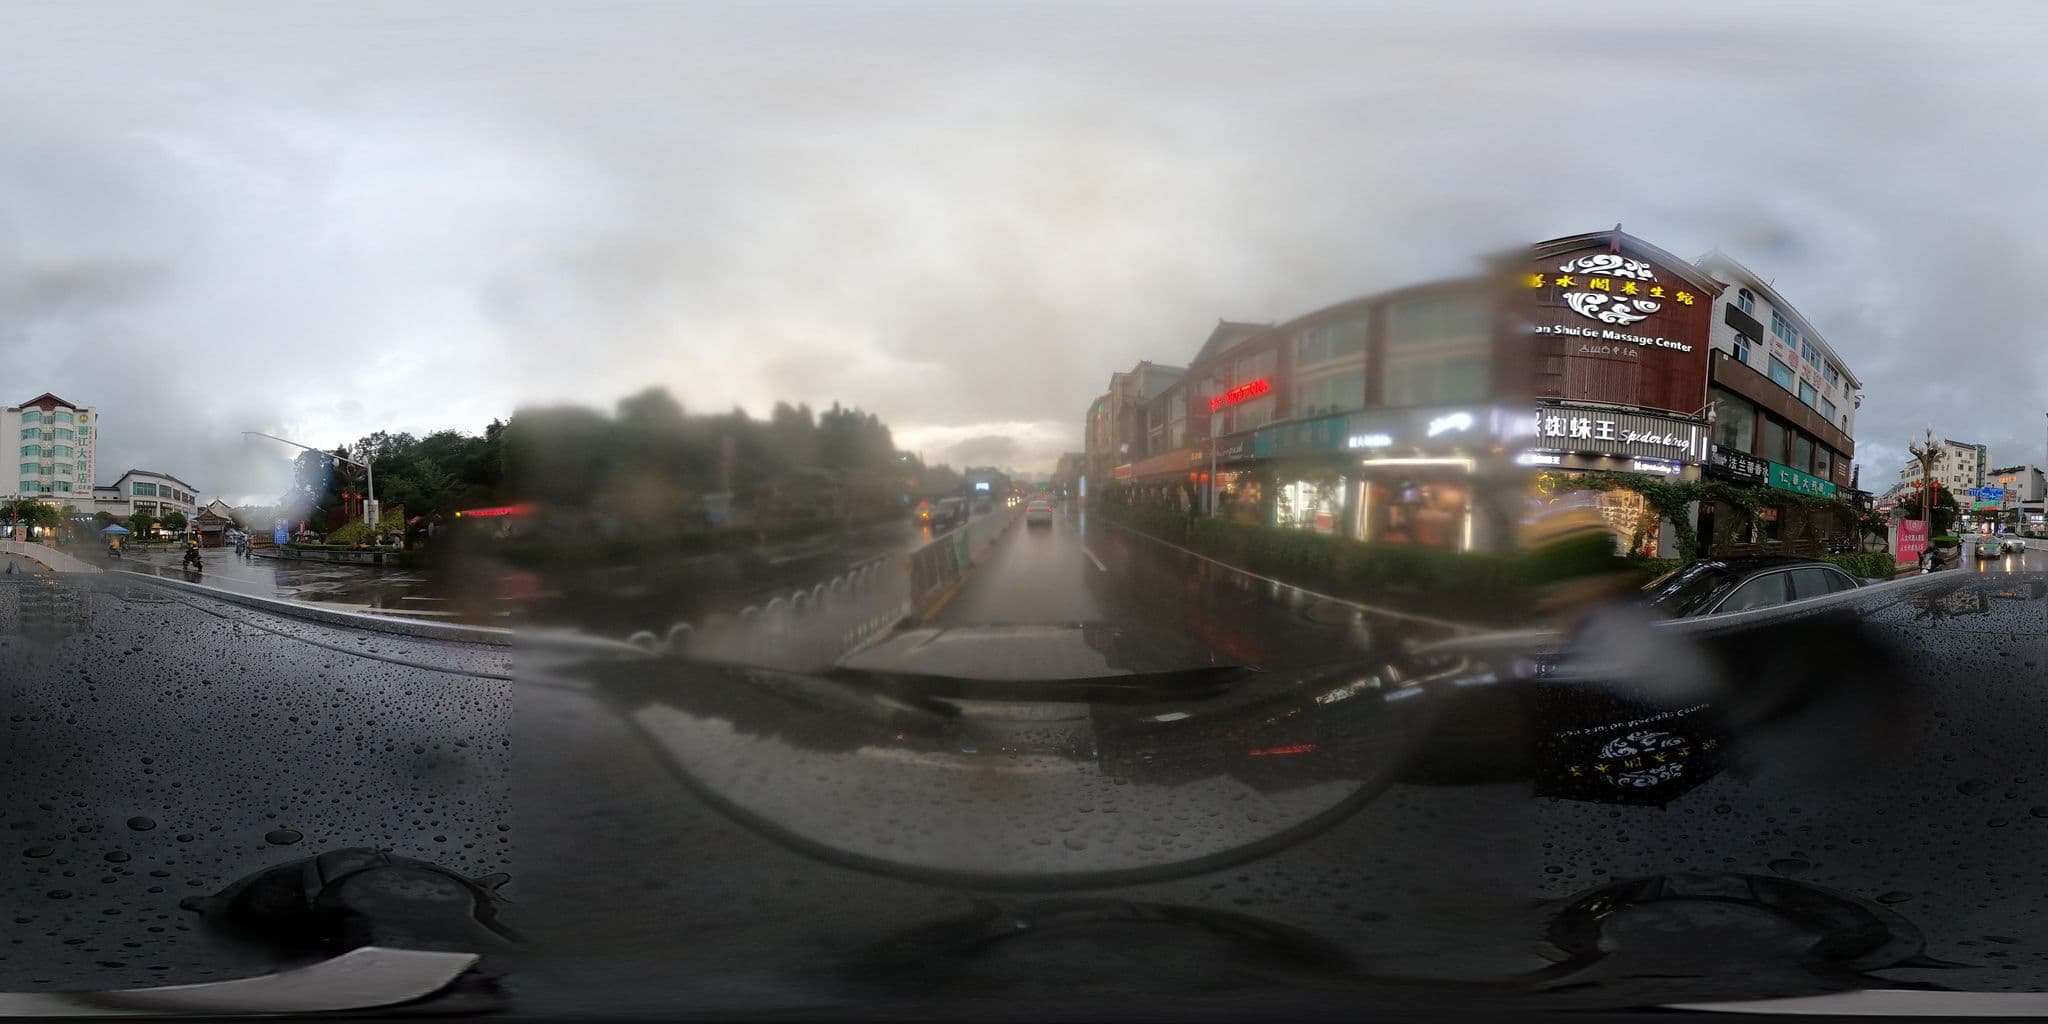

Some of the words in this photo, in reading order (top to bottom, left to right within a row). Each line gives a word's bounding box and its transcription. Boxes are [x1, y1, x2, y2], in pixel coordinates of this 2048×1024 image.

[1554, 325, 1580, 336] Shui
[1583, 328, 1599, 338] Ge
[1602, 330, 1653, 346] Massage
[1656, 337, 1692, 353] Center
[1545, 415, 1616, 441] 蜘蛛王
